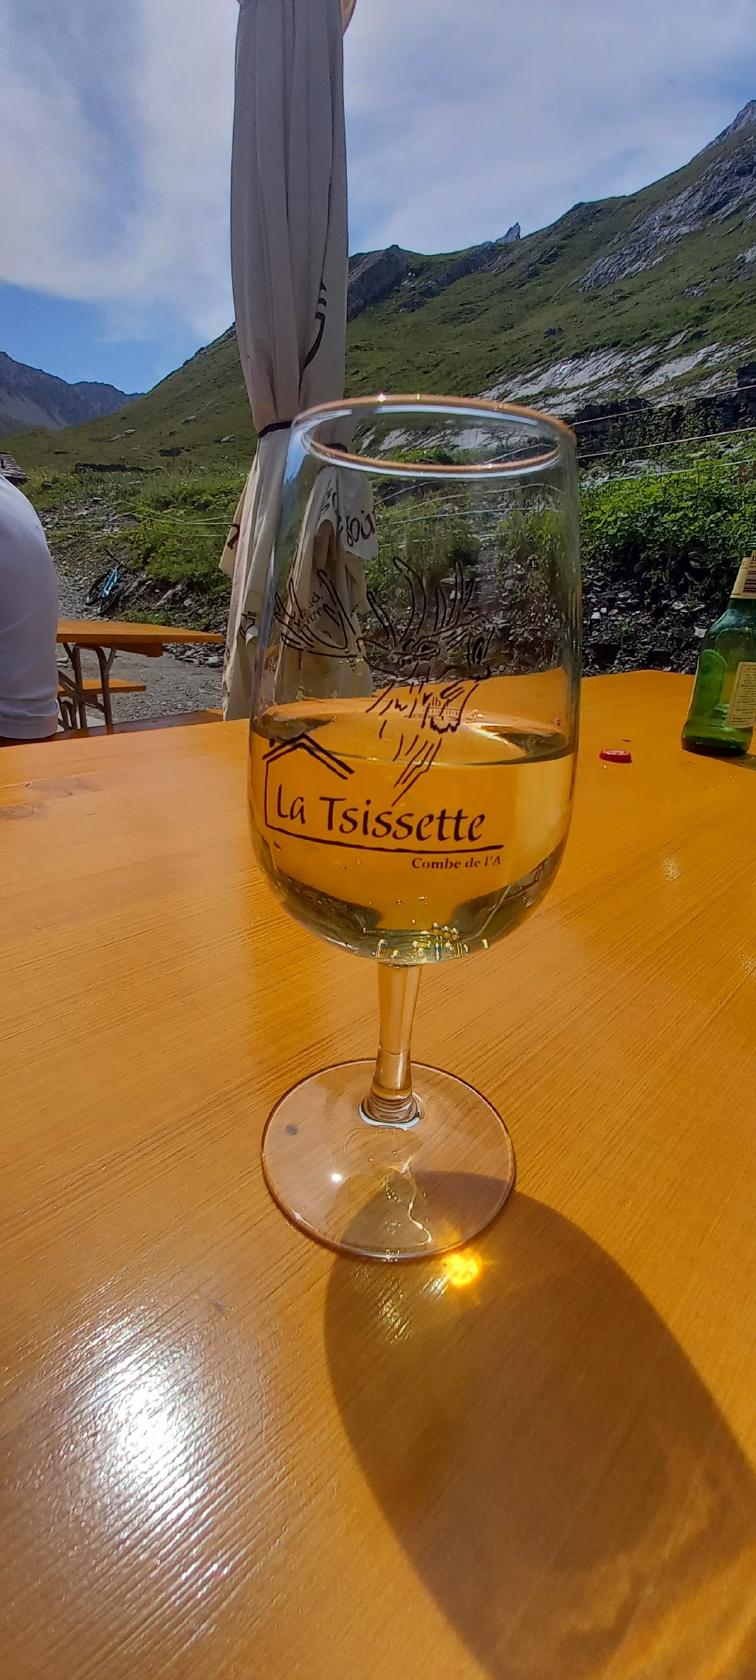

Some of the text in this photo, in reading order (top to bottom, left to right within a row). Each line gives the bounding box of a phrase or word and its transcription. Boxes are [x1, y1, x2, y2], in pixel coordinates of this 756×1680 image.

[277, 784, 486, 842] La Tsissette
[411, 857, 461, 870] Combe
[465, 856, 481, 869] de
